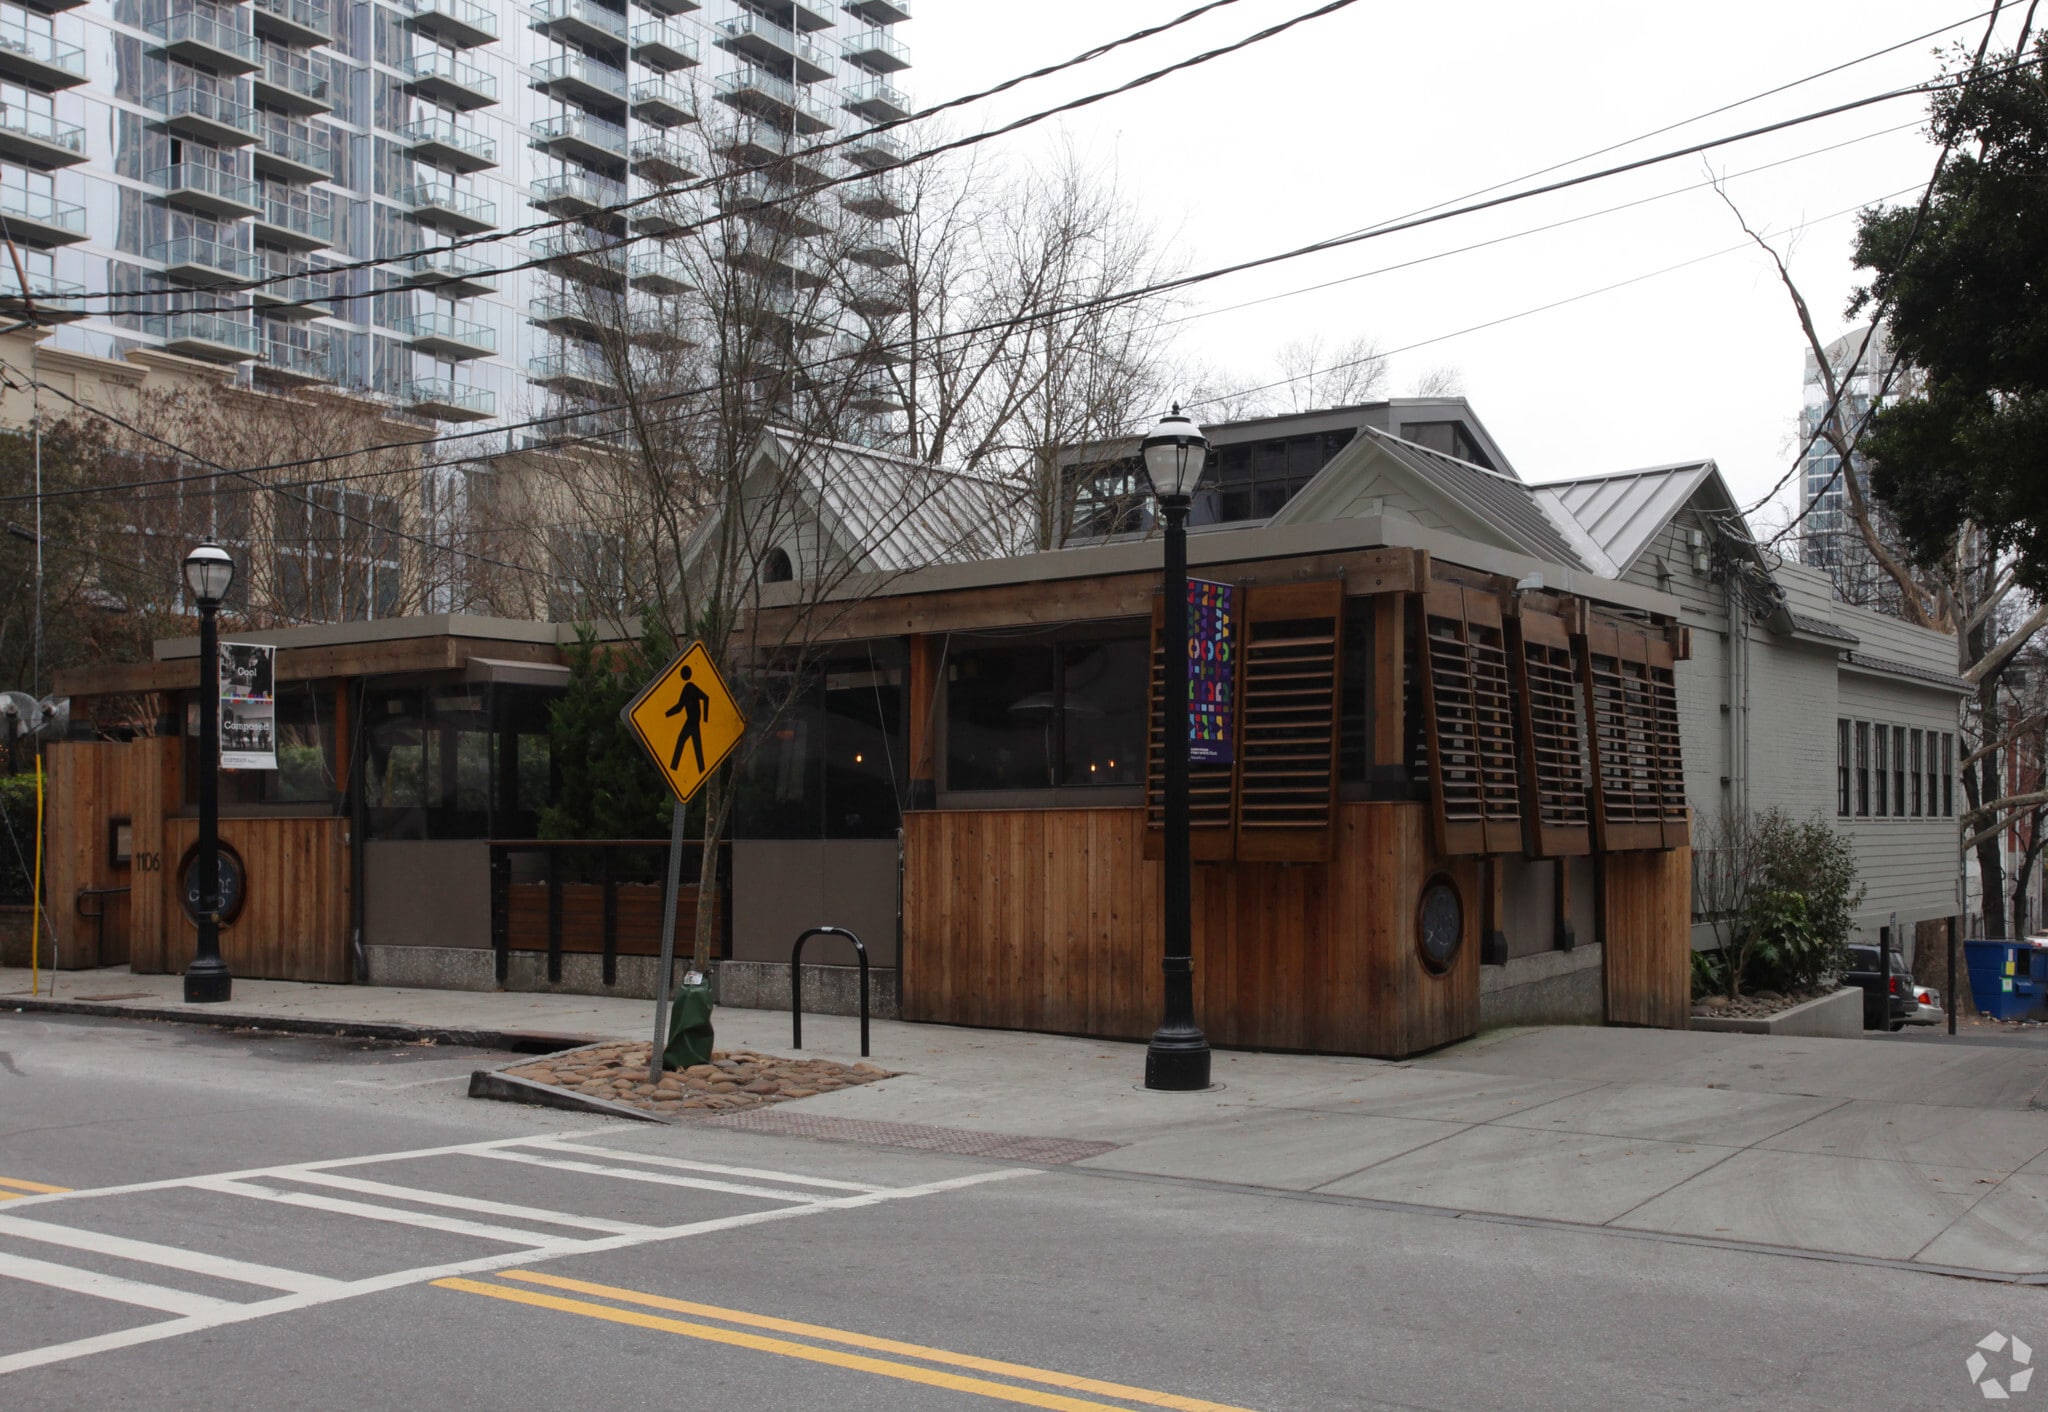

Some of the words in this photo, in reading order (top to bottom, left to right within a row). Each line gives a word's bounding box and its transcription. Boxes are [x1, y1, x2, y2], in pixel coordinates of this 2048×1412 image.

[237, 666, 257, 677] Cool
[224, 720, 270, 733] Composed
[136, 851, 160, 872] 1106
